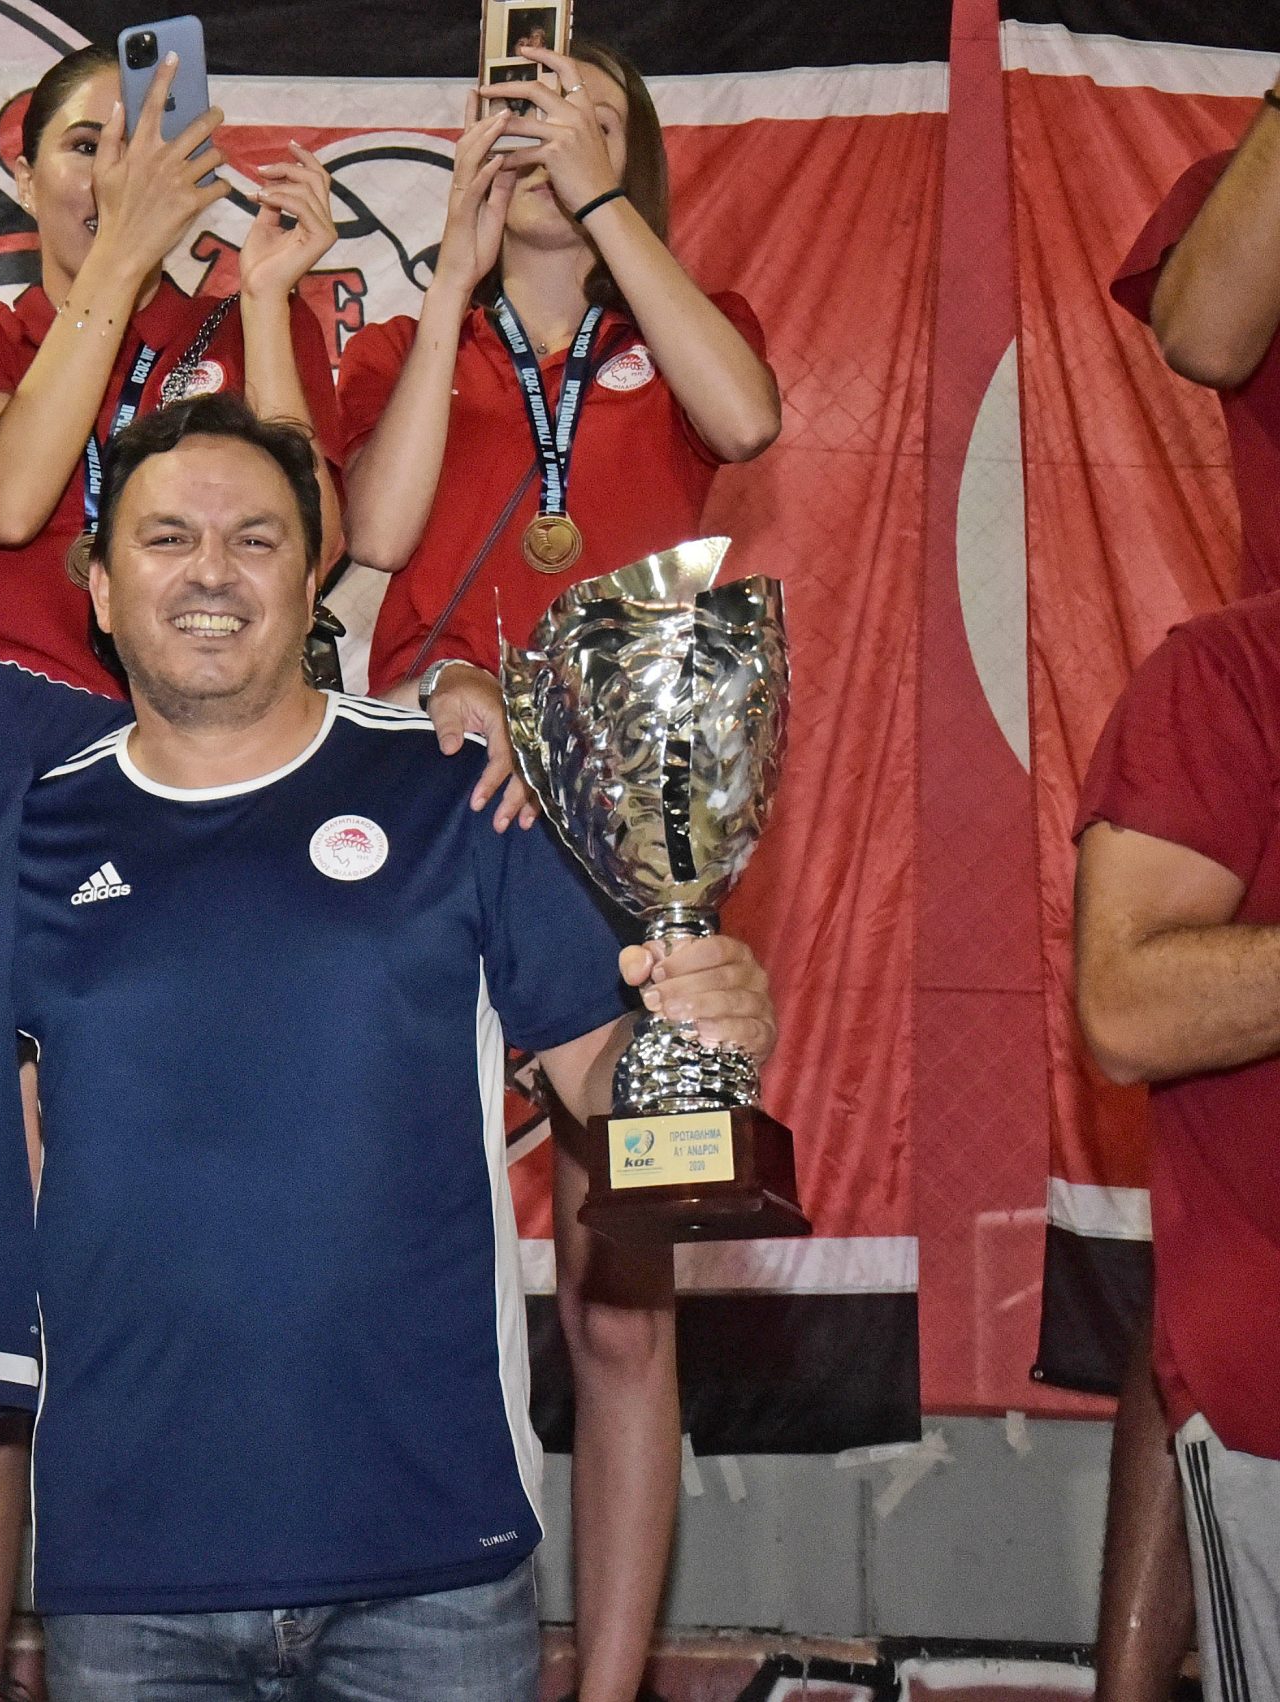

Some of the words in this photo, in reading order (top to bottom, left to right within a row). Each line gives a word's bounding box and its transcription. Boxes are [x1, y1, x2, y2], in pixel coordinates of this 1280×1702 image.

[572, 332, 591, 358] 2020
[130, 360, 152, 385] 2020
[521, 367, 541, 394] 2020
[529, 394, 553, 446] ΓΥΝΑΙΚΩΝ
[556, 379, 581, 453] ΠΡΩΤΑΘΛΗΜΑ
[70, 884, 131, 905] adidas
[669, 1128, 722, 1142] ΠΡΩΤΑΘΛΗΜΑ
[687, 1144, 720, 1156] ΑΝΔΡΩΝ
[689, 1160, 706, 1172] 2020
